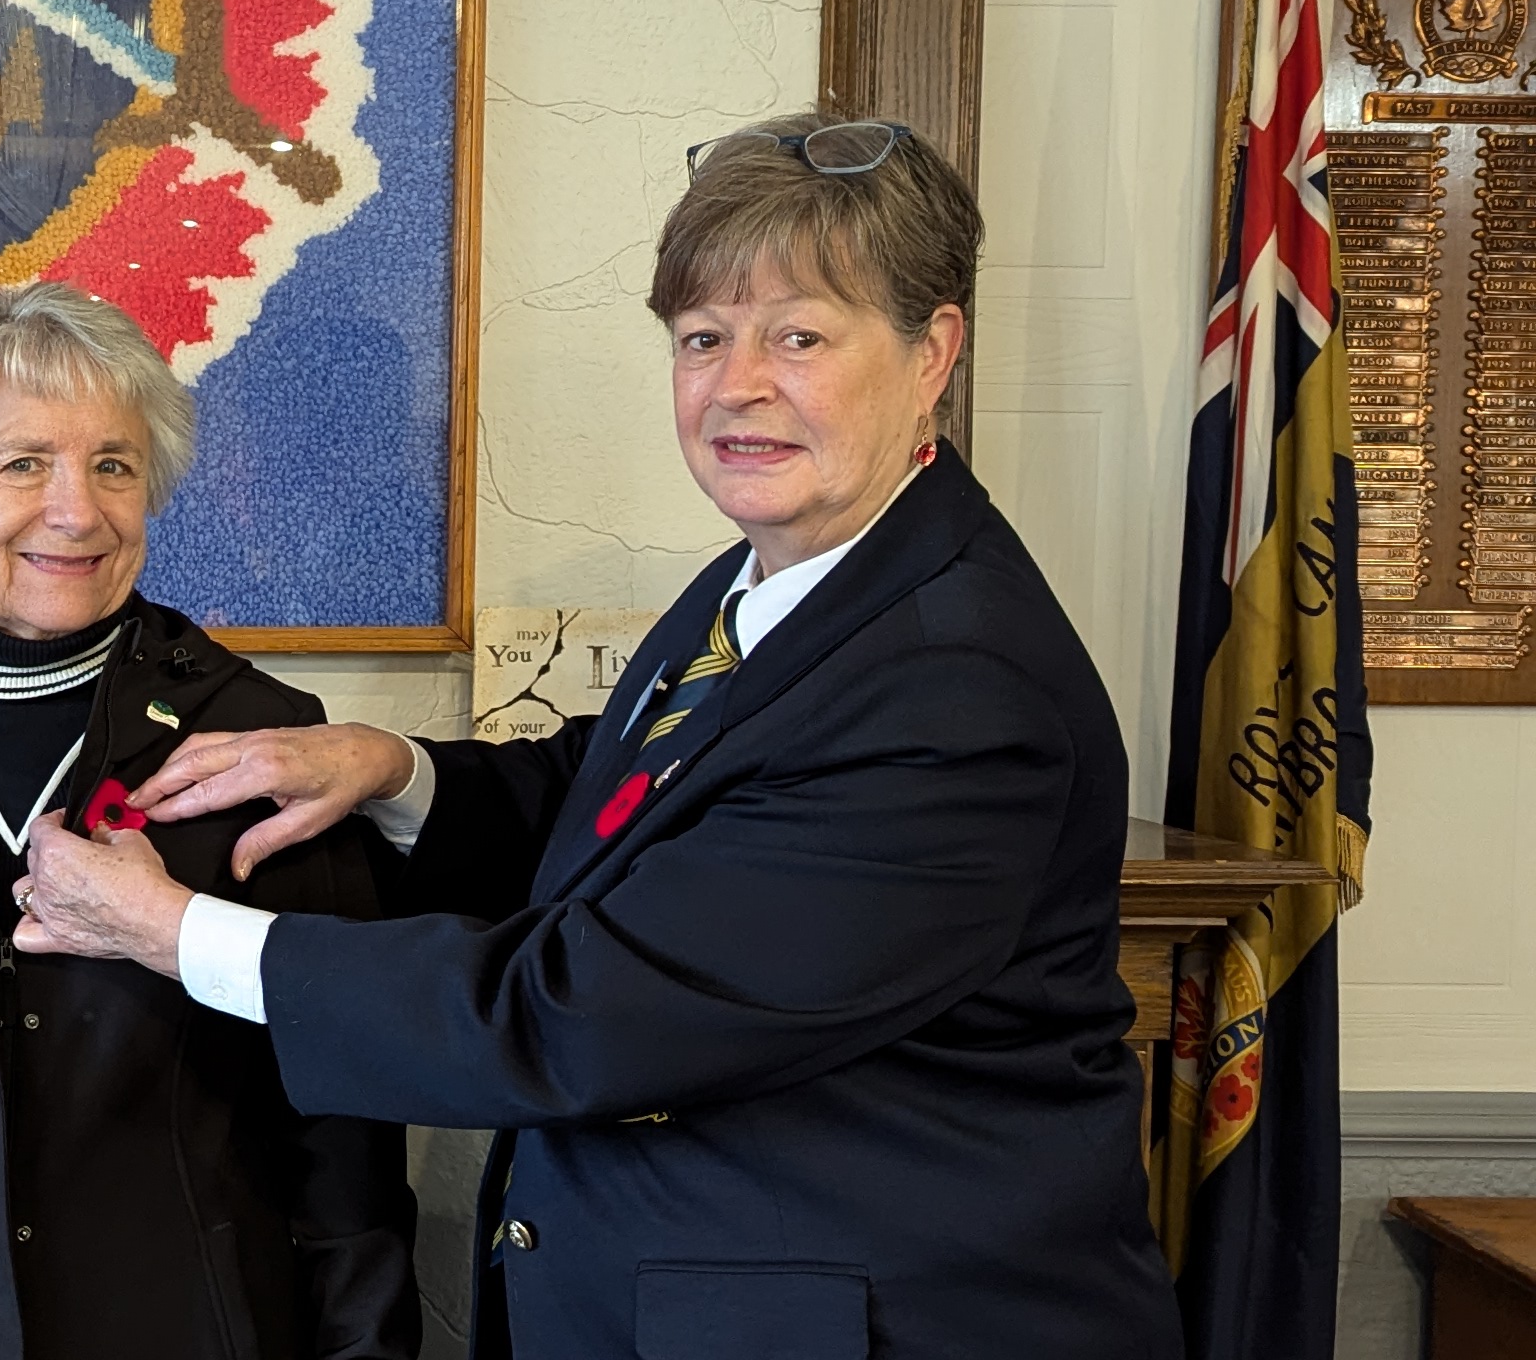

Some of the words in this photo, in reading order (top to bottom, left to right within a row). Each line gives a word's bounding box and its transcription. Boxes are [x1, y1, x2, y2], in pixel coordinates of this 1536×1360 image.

[1442, 41, 1504, 55] LEGION
[1395, 102, 1432, 115] PAST
[1350, 156, 1406, 166] STEVENS
[1358, 278, 1410, 288] HUNTER
[1350, 298, 1395, 308] BROWN
[1352, 413, 1402, 423] WALKER
[516, 629, 552, 647] may
[484, 644, 533, 668] You
[484, 717, 501, 734] of
[508, 722, 546, 739] your
